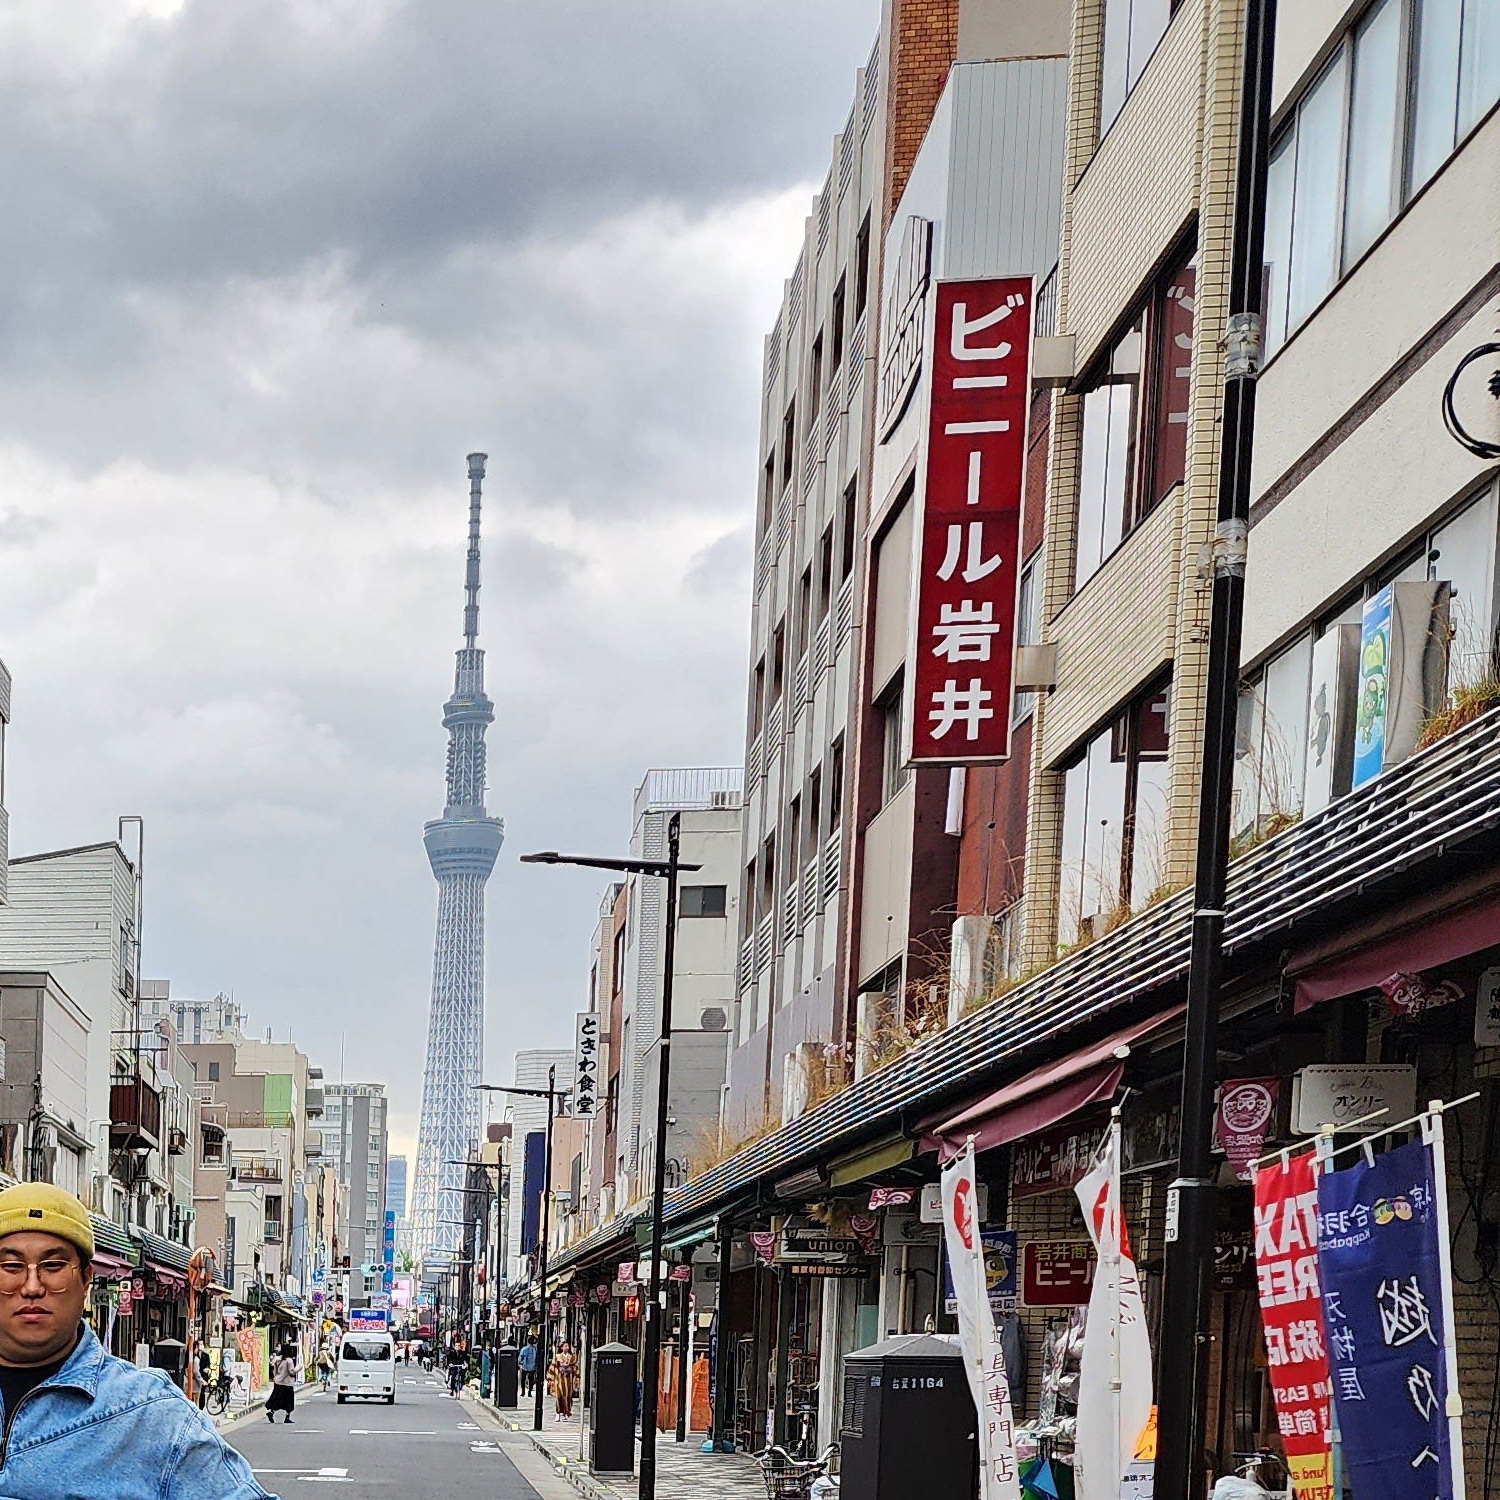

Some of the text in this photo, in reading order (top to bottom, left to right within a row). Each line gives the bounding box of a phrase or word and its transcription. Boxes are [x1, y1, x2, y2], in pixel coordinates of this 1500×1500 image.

[928, 293, 1025, 740] ビニール岩井
[576, 1018, 598, 1115] ときわ食堂
[1335, 1095, 1385, 1108] オンリー
[808, 1240, 855, 1251] union
